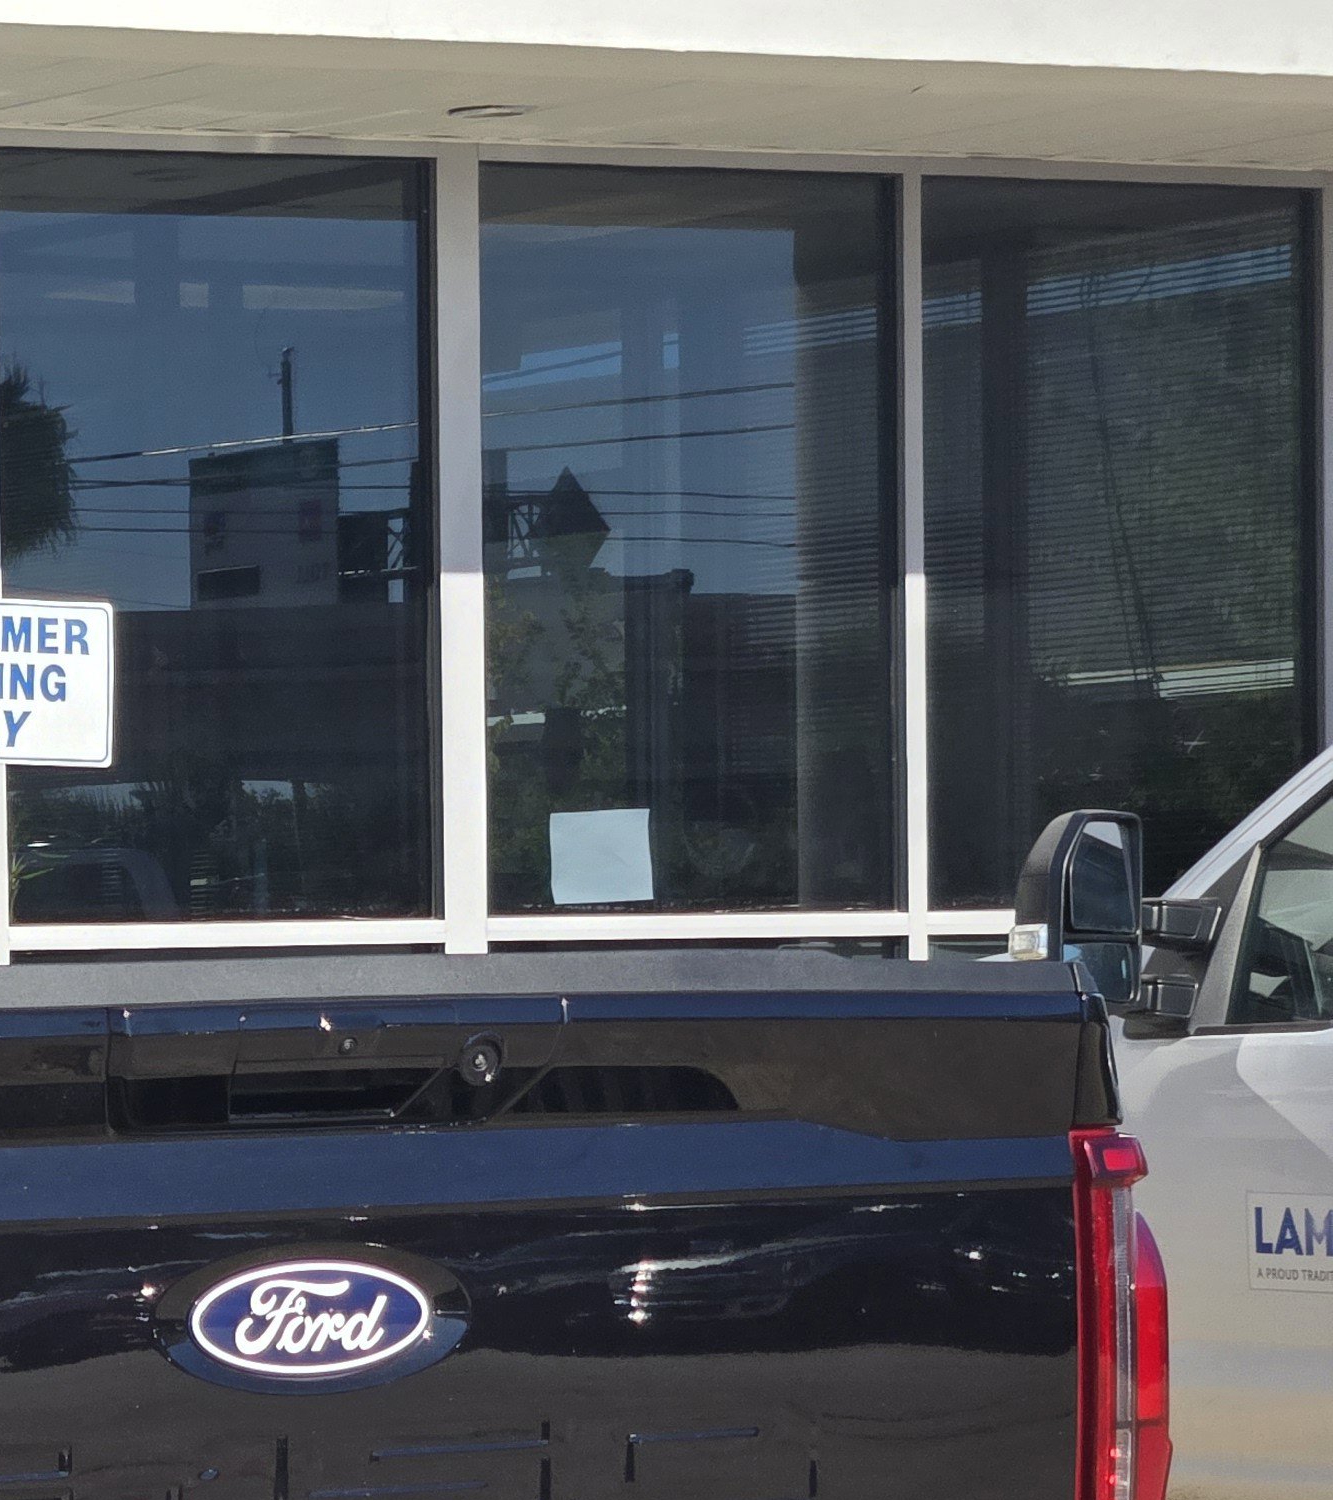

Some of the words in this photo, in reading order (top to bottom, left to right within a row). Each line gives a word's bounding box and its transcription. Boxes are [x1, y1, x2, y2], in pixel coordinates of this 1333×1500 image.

[1256, 1267, 1264, 1279] A
[1265, 1267, 1299, 1280] PROUD
[235, 1279, 387, 1354] Ford
